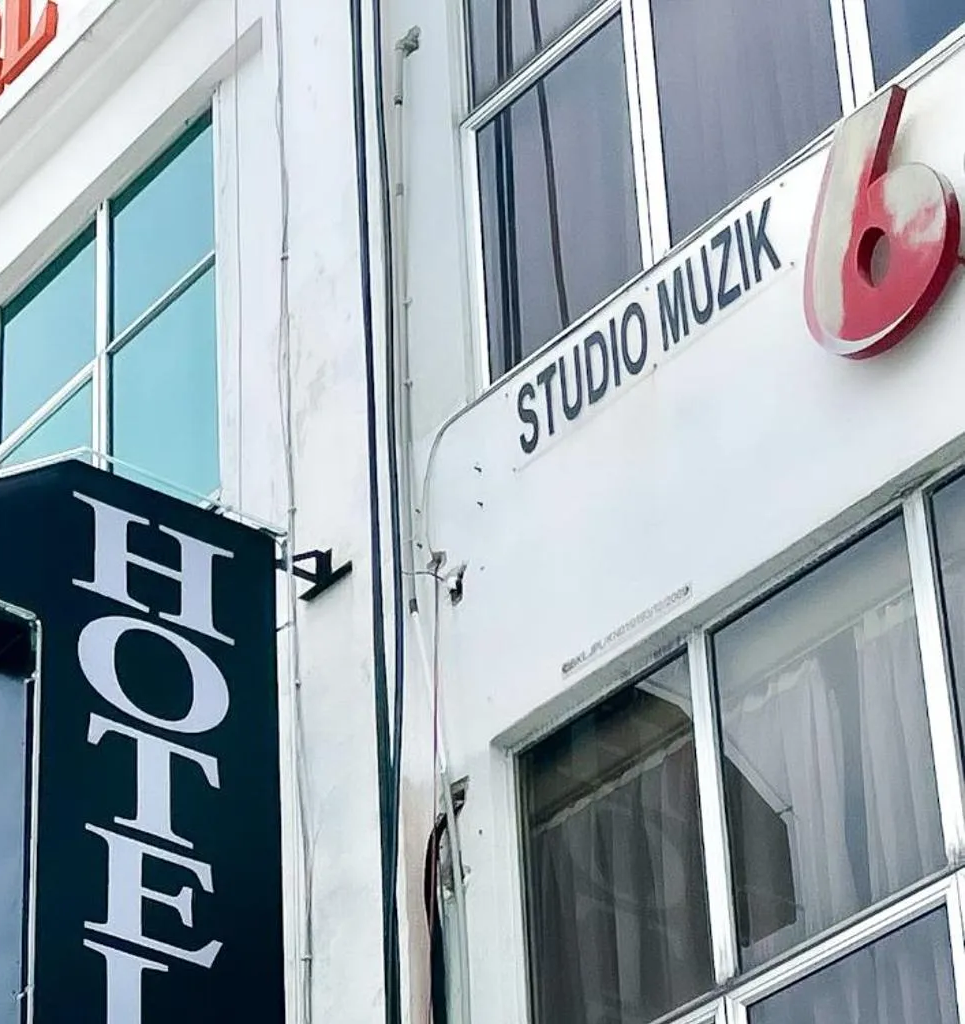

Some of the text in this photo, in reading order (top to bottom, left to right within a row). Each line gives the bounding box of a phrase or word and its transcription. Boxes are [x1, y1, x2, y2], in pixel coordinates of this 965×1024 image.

[516, 198, 782, 455] STUDIO MUZIK
[804, 84, 960, 360] 6
